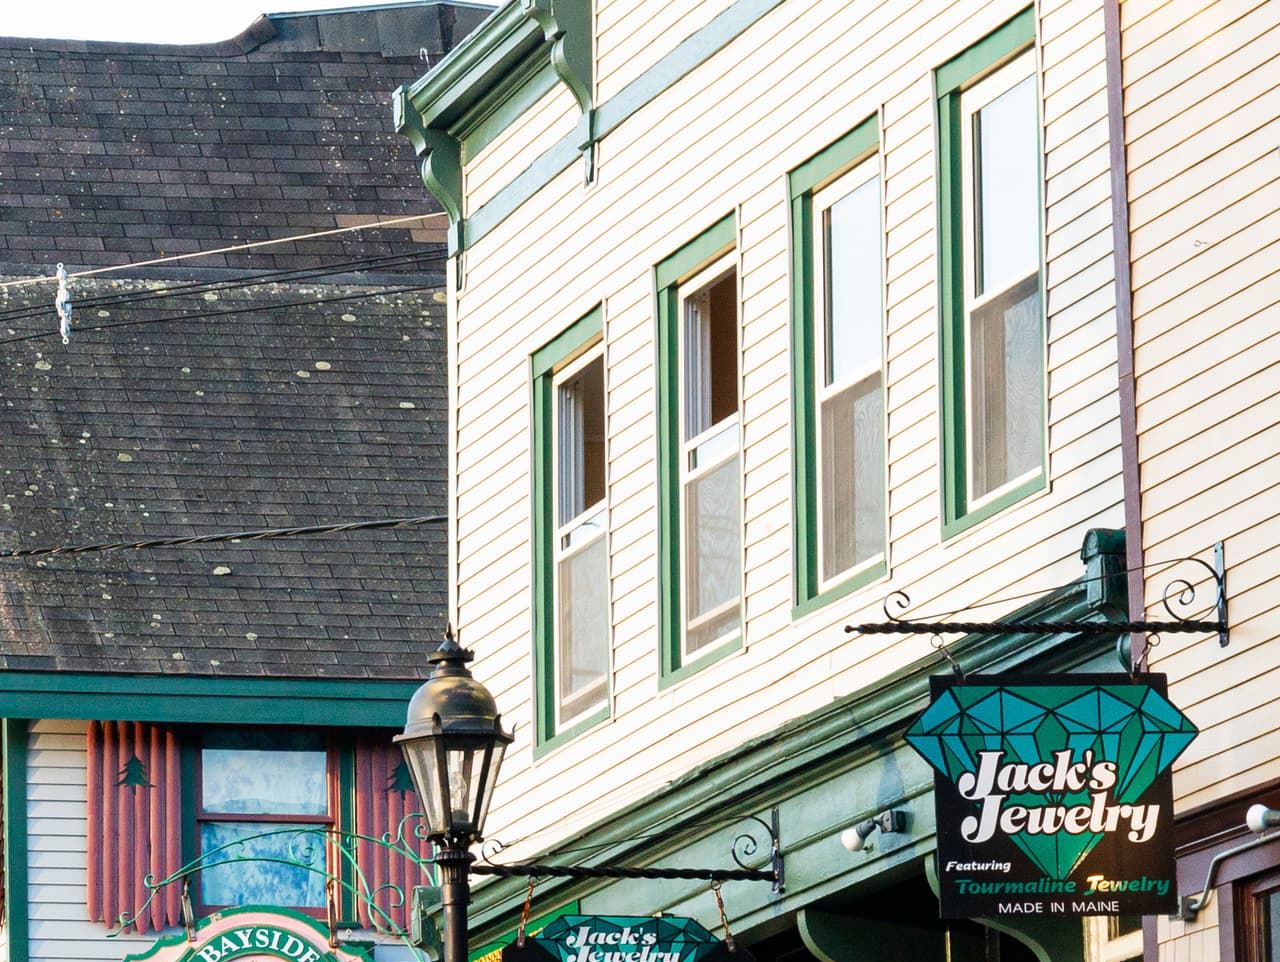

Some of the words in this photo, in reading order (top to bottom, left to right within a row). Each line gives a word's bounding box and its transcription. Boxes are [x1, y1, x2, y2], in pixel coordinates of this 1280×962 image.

[958, 750, 1117, 800] Jack's
[960, 792, 1160, 843] Jewelry
[945, 861, 1012, 873] Featuring
[954, 878, 1076, 895] Tourmaline
[1083, 875, 1170, 896] Jewelry
[998, 902, 1043, 913] MADE
[1050, 902, 1065, 912] IN
[1072, 901, 1120, 912] MAINE
[566, 926, 657, 948] Jack's
